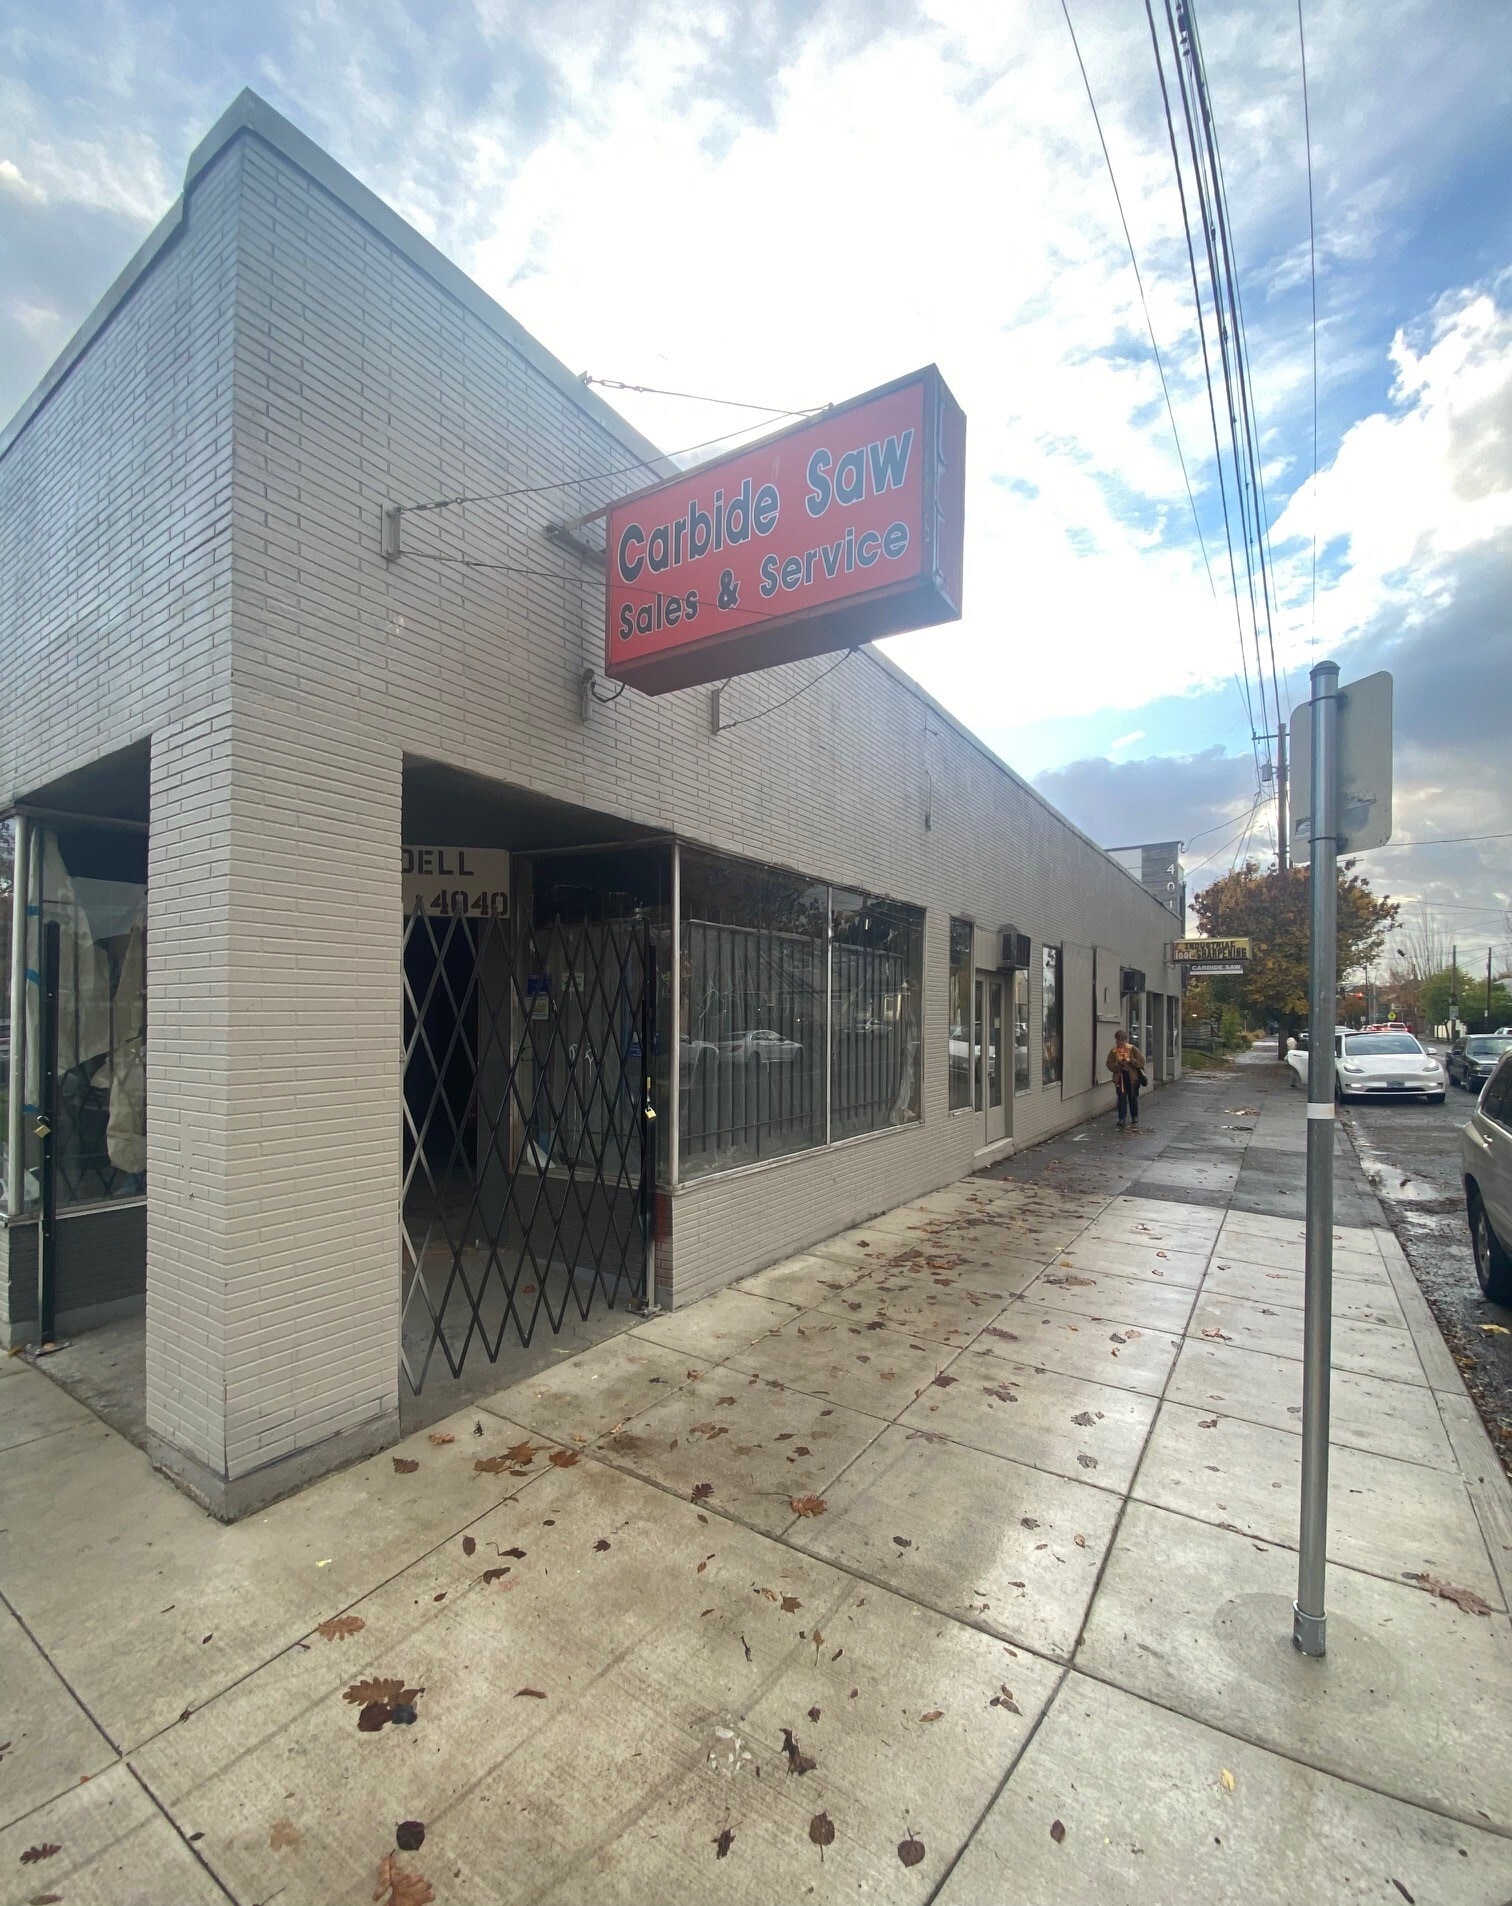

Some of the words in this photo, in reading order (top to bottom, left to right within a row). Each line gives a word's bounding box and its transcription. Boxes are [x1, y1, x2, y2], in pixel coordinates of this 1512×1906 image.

[618, 477, 780, 584] Carbide
[805, 428, 914, 518] Saw
[618, 590, 699, 640] Sales
[717, 568, 740, 611] &
[759, 521, 910, 598] Service
[430, 889, 508, 916] 4040
[1196, 947, 1247, 959] SHARPENING
